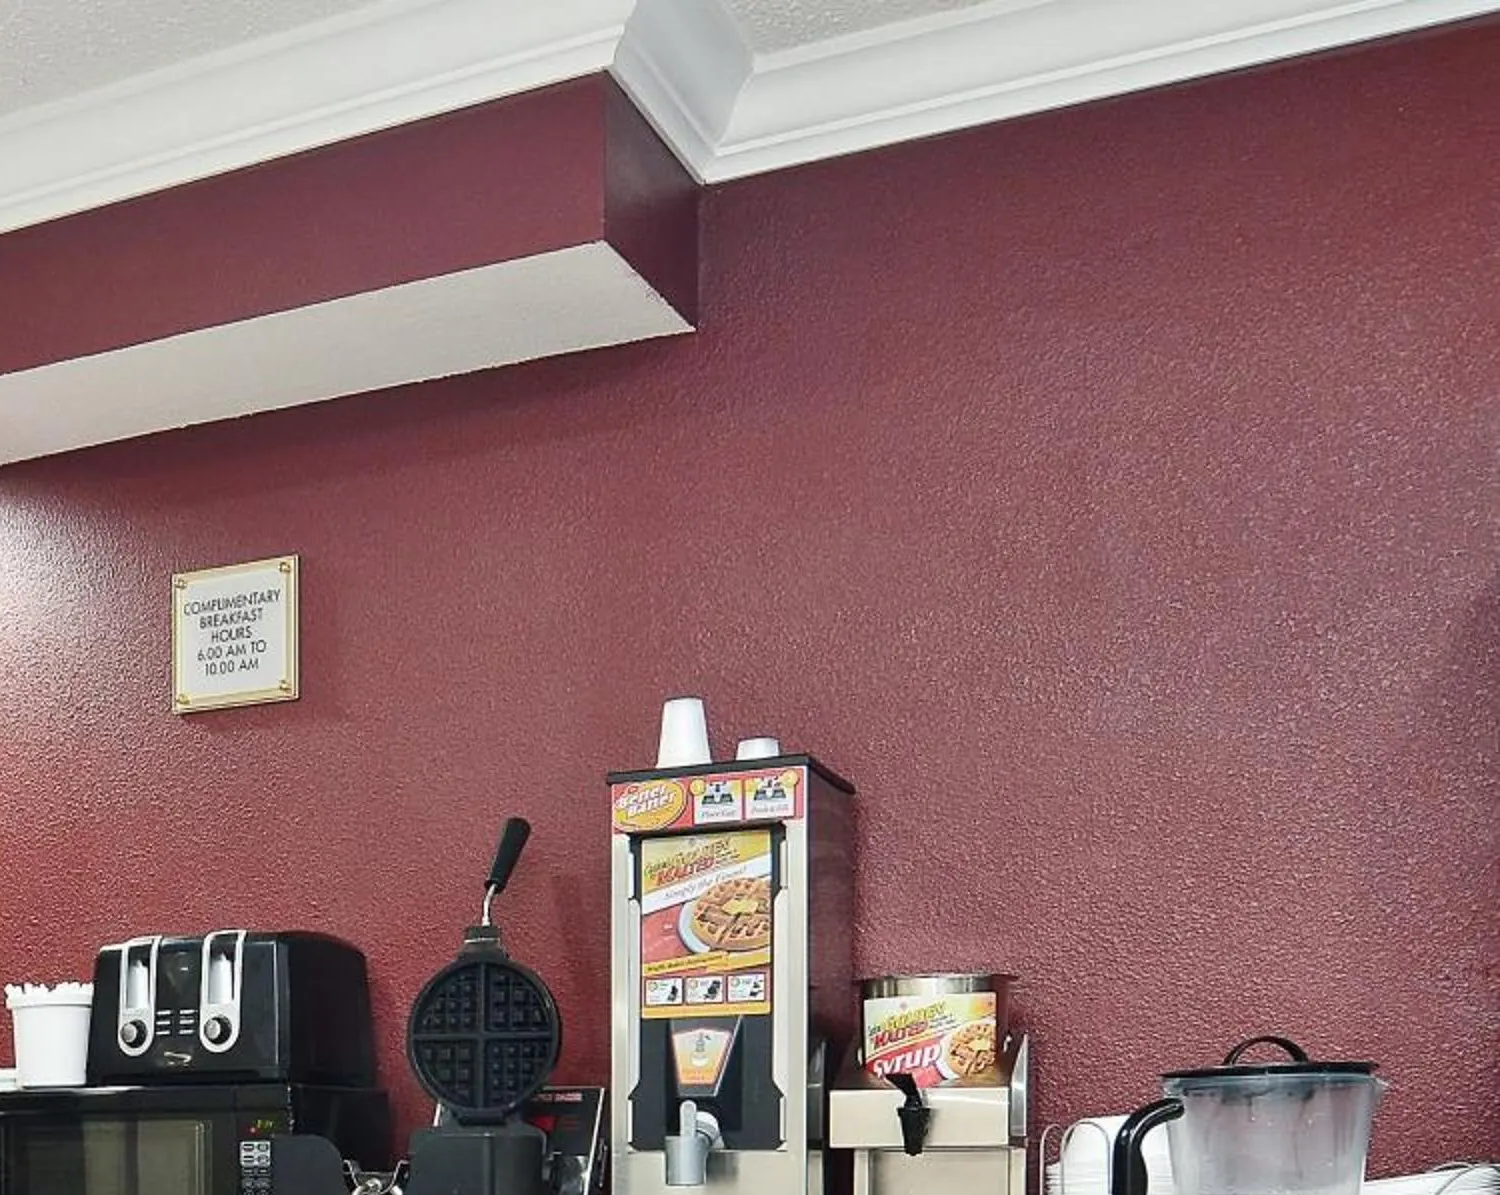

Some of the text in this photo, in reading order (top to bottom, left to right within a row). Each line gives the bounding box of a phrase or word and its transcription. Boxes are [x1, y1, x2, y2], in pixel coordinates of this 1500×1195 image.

[199, 607, 263, 629] BREAKFAST
[211, 625, 253, 643] HOURS
[225, 643, 248, 658] AM
[250, 639, 267, 654] TO
[237, 656, 260, 672] AM
[872, 1042, 942, 1079] Syrup
